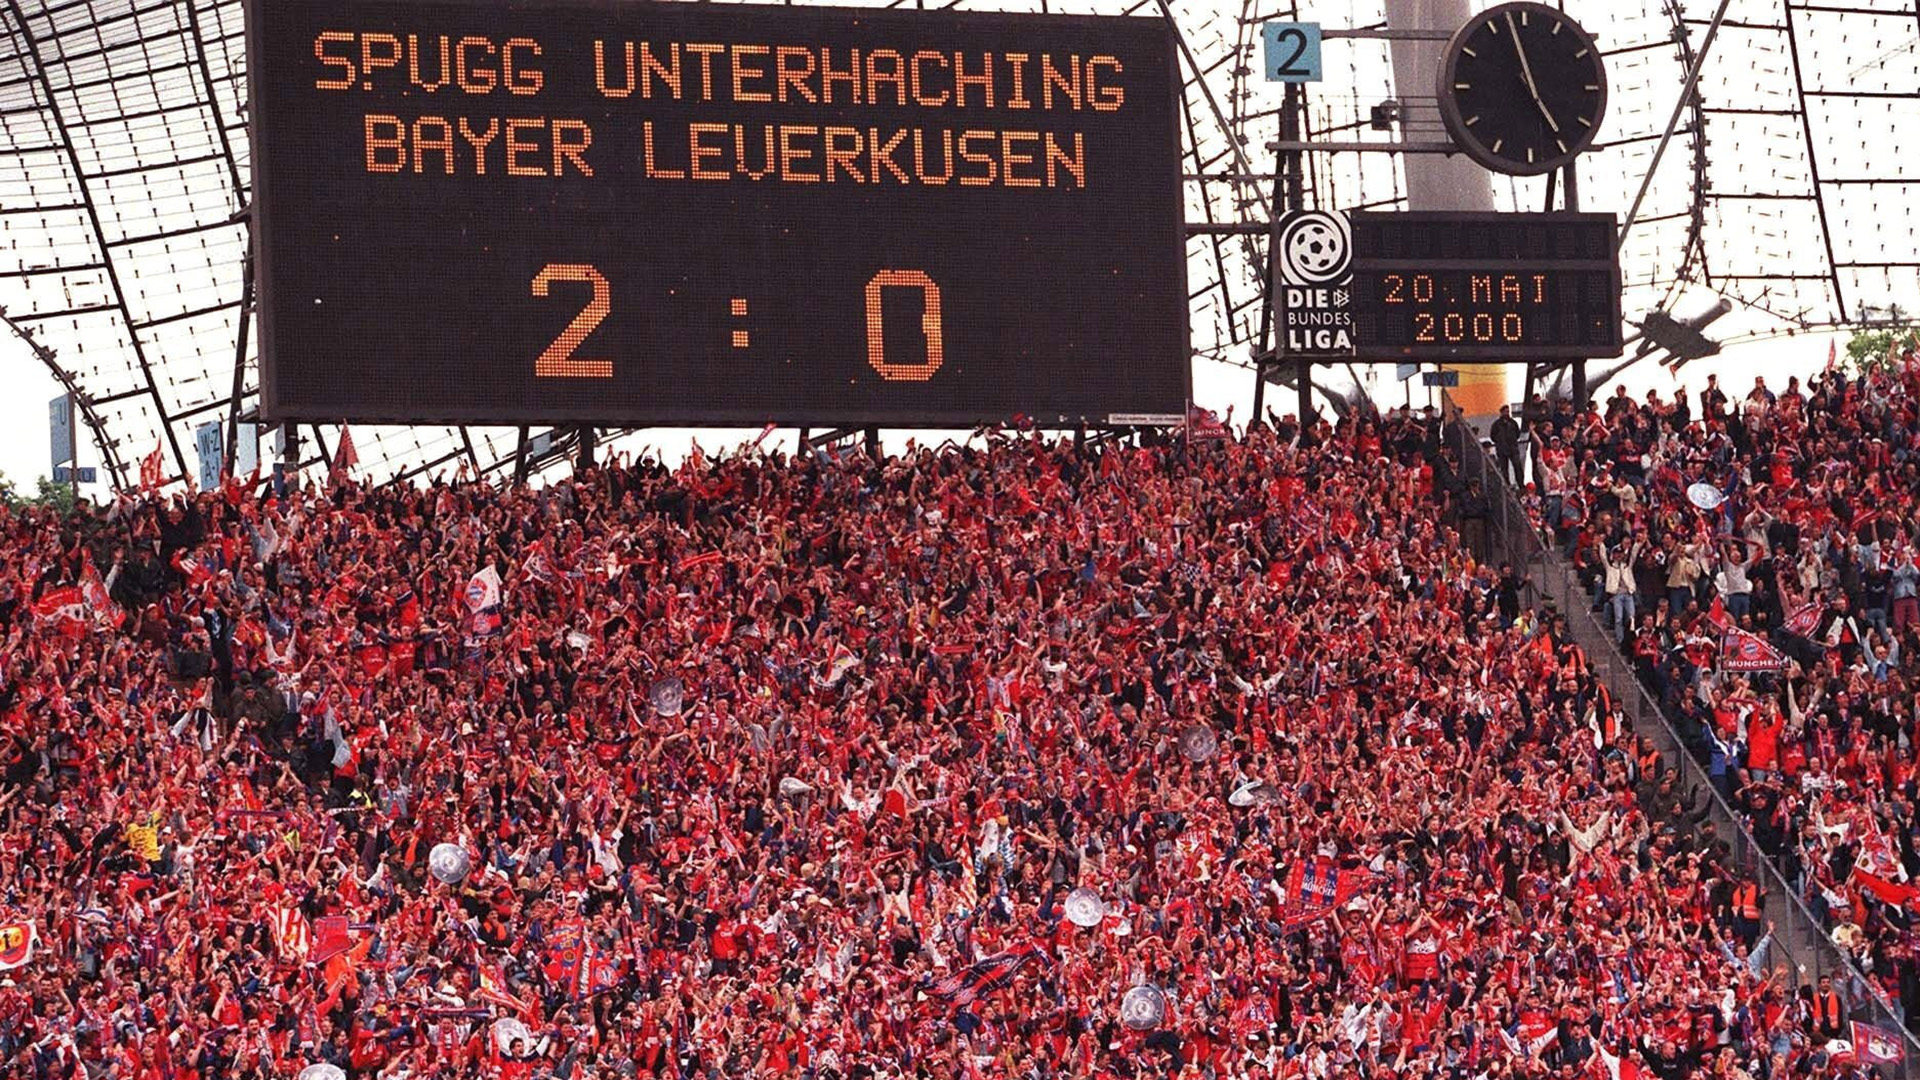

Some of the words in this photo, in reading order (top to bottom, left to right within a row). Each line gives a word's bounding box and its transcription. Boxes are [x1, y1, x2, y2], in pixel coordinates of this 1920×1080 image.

[1278, 28, 1310, 76] 2
[594, 40, 1124, 111] UNTERHACHING
[365, 114, 593, 176] BAYER
[644, 121, 1085, 188] LEVERKUSEN
[1287, 290, 1328, 308] DIE
[532, 264, 613, 377] 2
[865, 269, 943, 381] 0
[1288, 312, 1351, 326] BUNDES
[1415, 312, 1523, 341] 2000
[1289, 329, 1353, 350] LIGA
